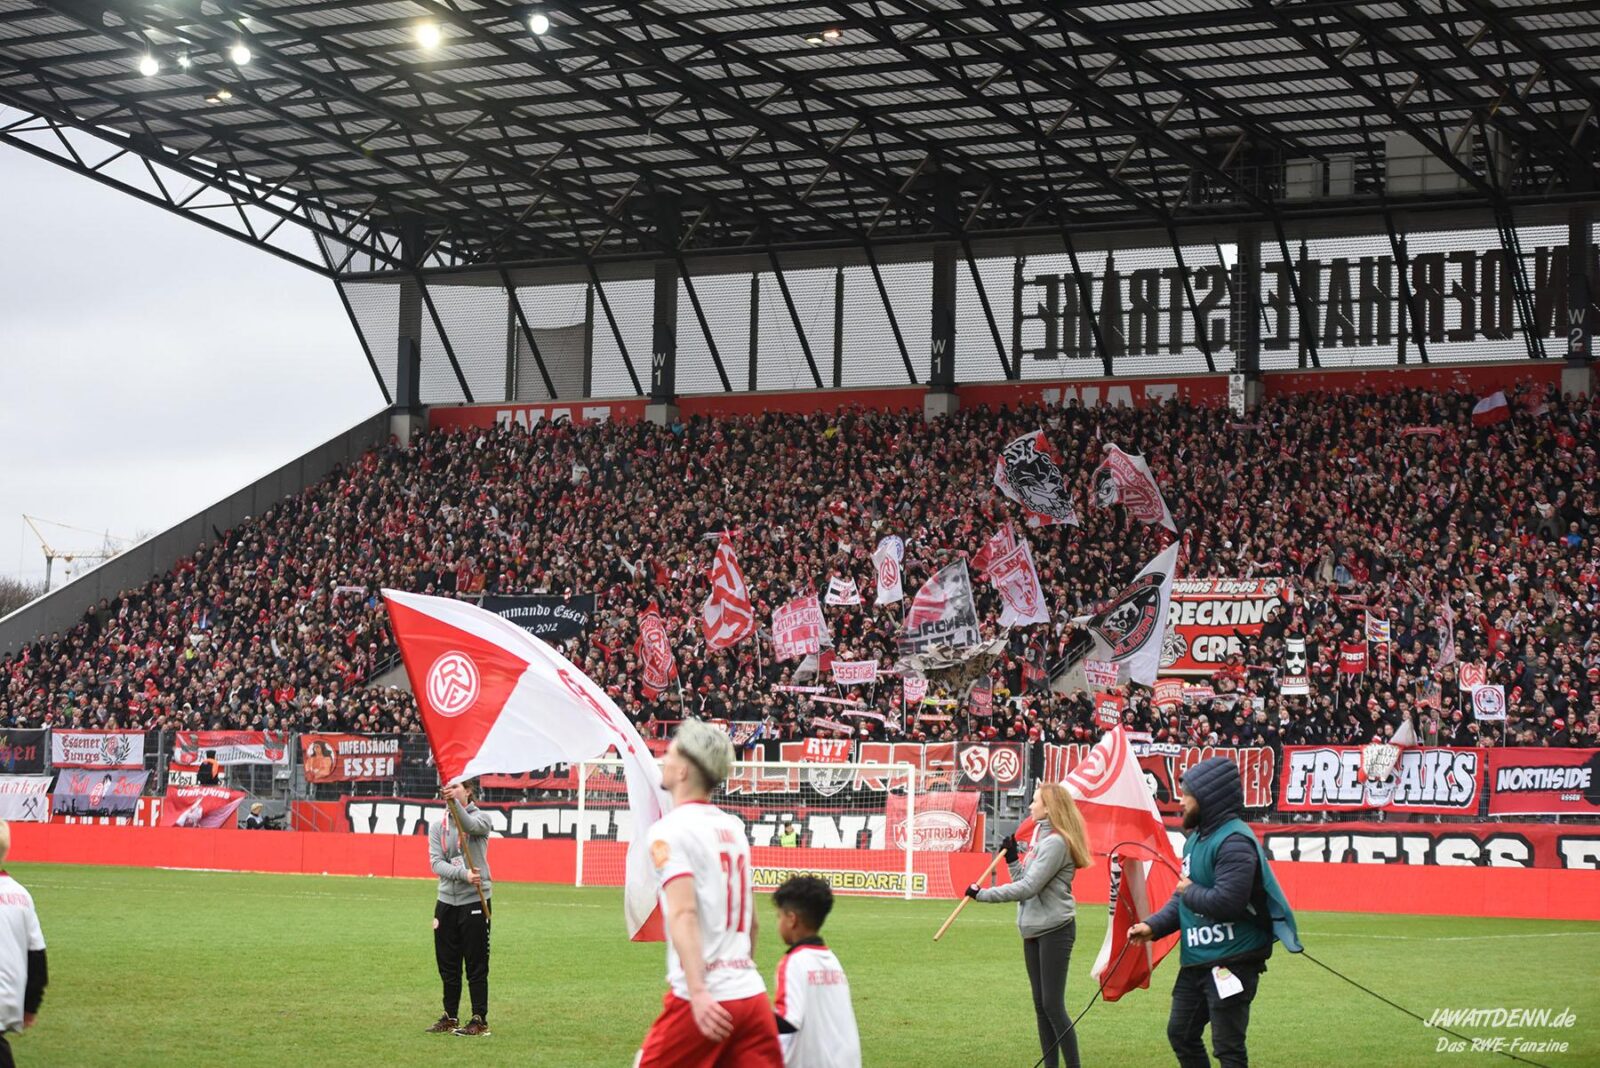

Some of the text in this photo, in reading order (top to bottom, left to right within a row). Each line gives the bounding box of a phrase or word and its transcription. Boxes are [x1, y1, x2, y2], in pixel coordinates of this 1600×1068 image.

[931, 338, 947, 354] W
[652, 352, 666, 367] W
[499, 603, 551, 620] mmando
[1166, 597, 1282, 626] RECKING
[535, 622, 559, 634] 2012
[62, 734, 101, 749] Essener
[63, 748, 100, 763] Jungs
[1496, 767, 1592, 792] NORTHSIDE
[1186, 922, 1236, 948] HOST
